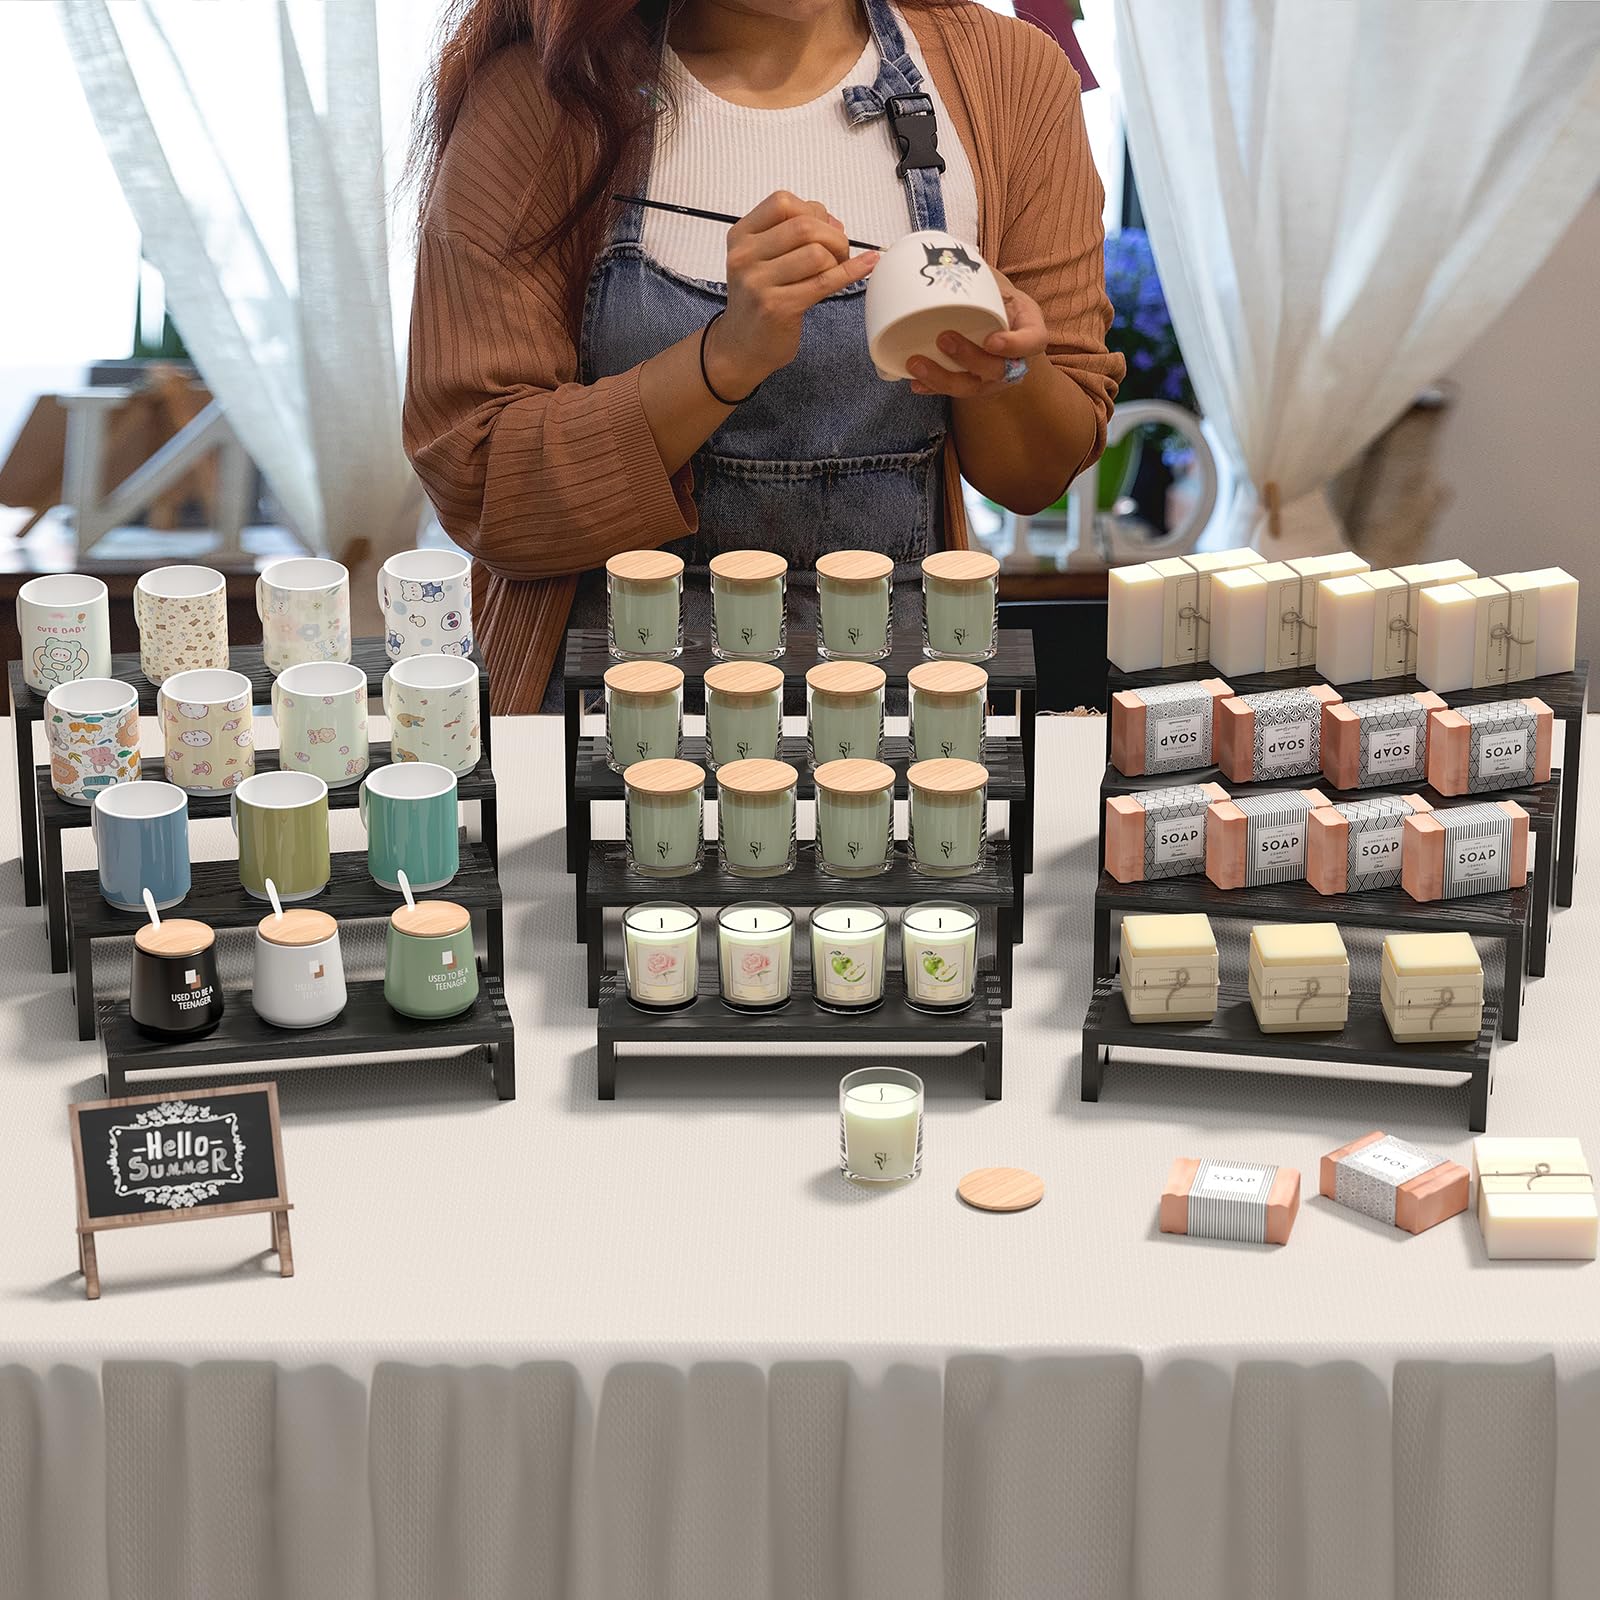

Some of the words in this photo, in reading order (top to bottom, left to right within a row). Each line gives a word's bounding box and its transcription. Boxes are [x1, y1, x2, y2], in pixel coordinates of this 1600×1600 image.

[37, 625, 58, 634] CUTE
[1160, 731, 1198, 746] SOAP
[1268, 738, 1305, 753] SOAP
[1373, 744, 1411, 759] SOAP
[1485, 744, 1522, 759] SOAP
[1160, 830, 1199, 845] SOAP
[1261, 837, 1299, 852] SOAP
[1361, 841, 1399, 856] SOAP
[1458, 849, 1496, 864] SOAP
[428, 974, 447, 983] USED
[447, 971, 457, 980] TO
[457, 968, 465, 978] BE
[435, 976, 467, 991] TEENAGER
[171, 992, 190, 1003] USED
[191, 990, 201, 1000] TO
[201, 987, 209, 997] BE
[208, 985, 214, 994] A
[178, 995, 212, 1010] TEENAGER
[1372, 1153, 1409, 1170] SOAP
[1213, 1173, 1256, 1184] SOAP
